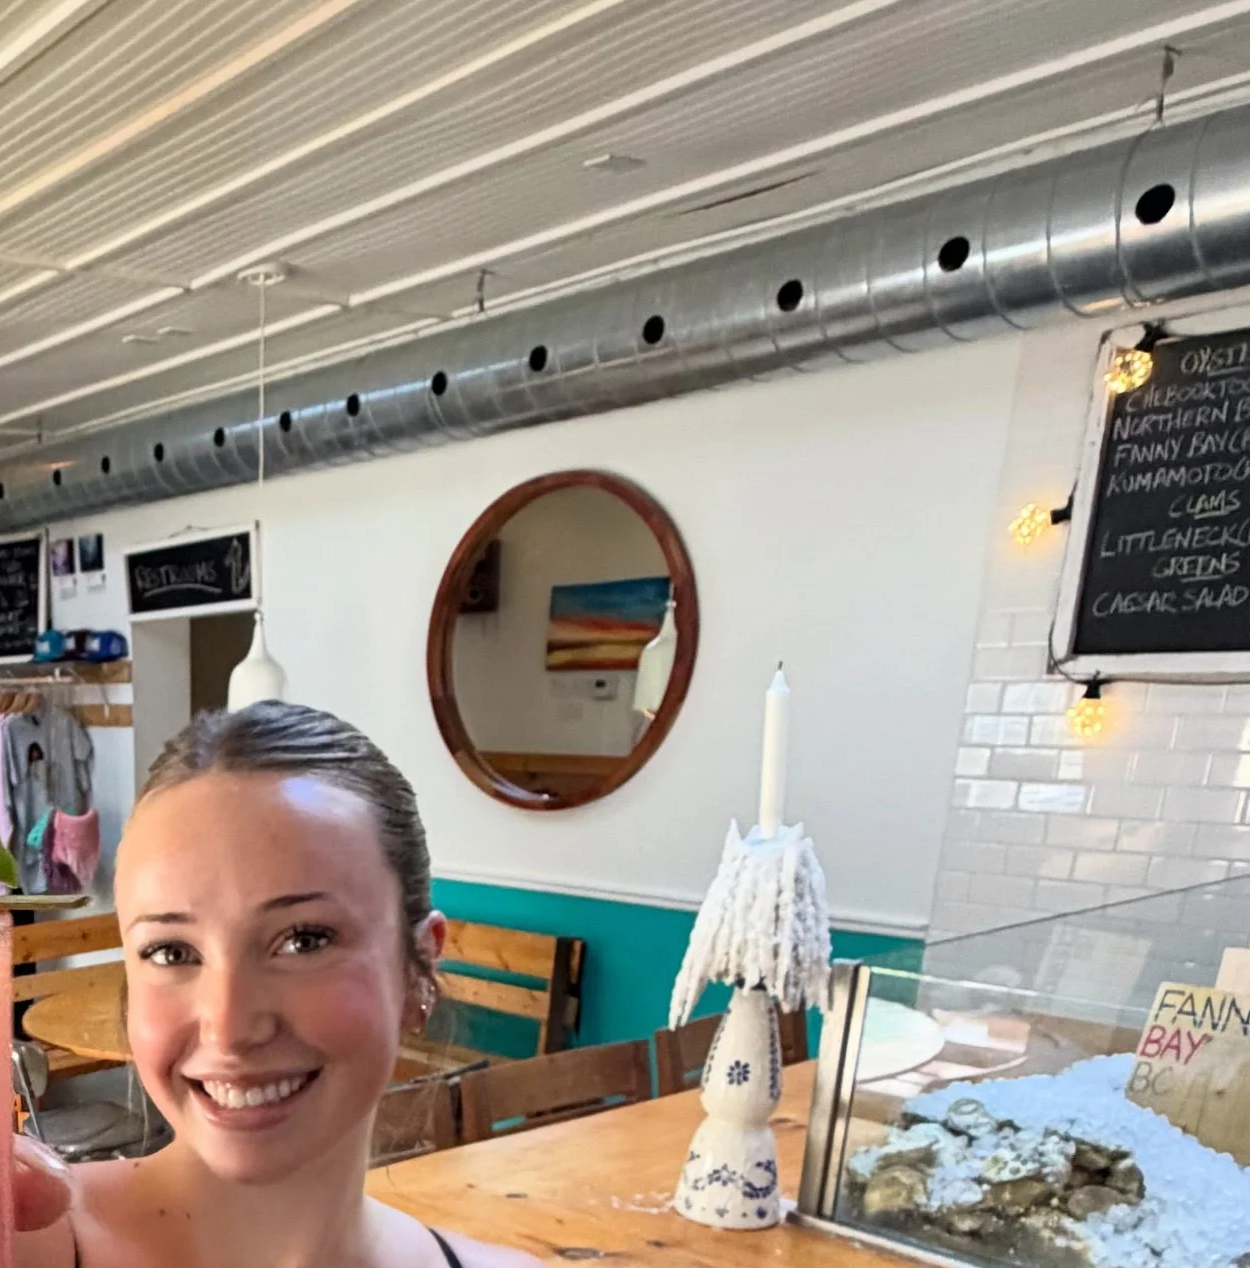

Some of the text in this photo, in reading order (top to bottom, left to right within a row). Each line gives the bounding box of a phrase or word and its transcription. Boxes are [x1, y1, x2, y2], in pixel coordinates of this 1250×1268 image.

[1113, 401, 1230, 441] NORTHERN
[1114, 434, 1184, 467] FANNY
[1168, 489, 1241, 518] CLAMS
[1153, 551, 1241, 578] GREENS
[1092, 584, 1249, 618] CAESAR SALAD
[1139, 1024, 1209, 1065] BAY
[1128, 1061, 1174, 1096] BC
